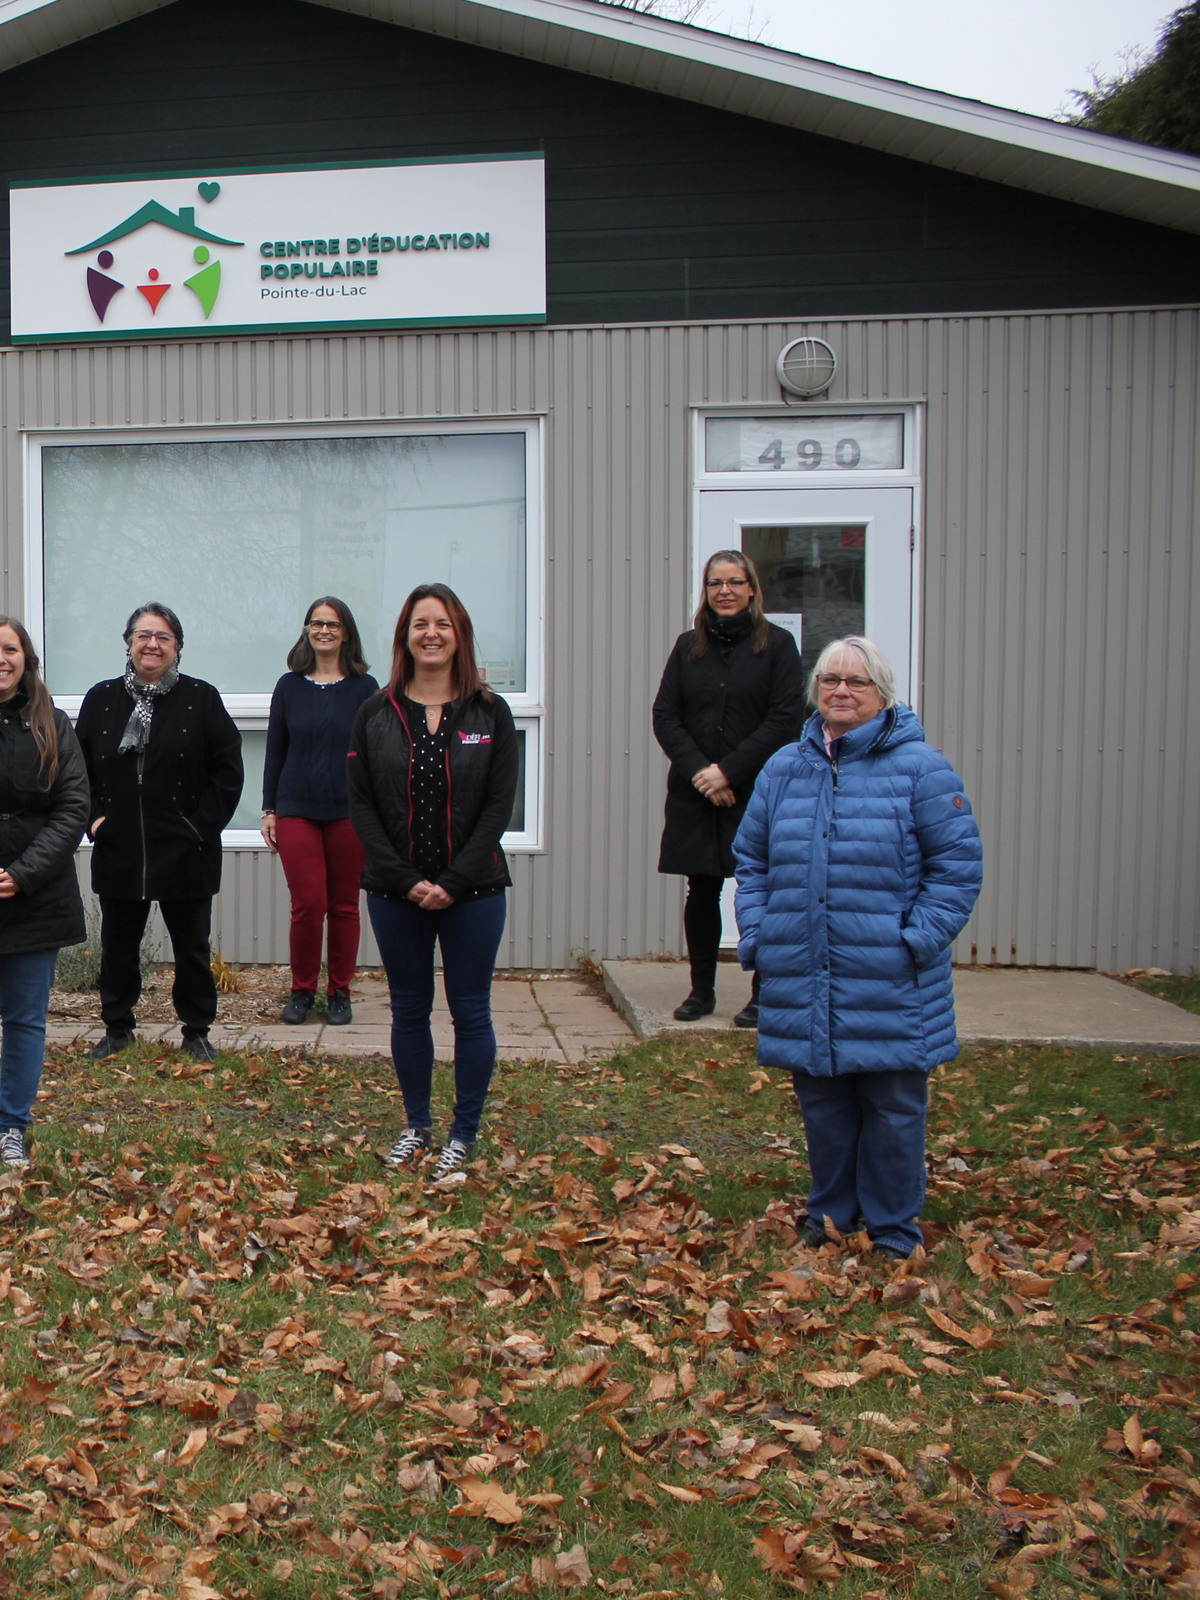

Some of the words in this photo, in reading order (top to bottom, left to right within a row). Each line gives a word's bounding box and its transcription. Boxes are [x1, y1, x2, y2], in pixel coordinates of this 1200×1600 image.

[259, 238, 341, 257] CENTRE
[346, 231, 490, 253] D'ÉDUCATION
[260, 259, 379, 280] POPULAIRE
[261, 285, 368, 300] Pointe-du-Lac
[758, 438, 861, 469] 490
